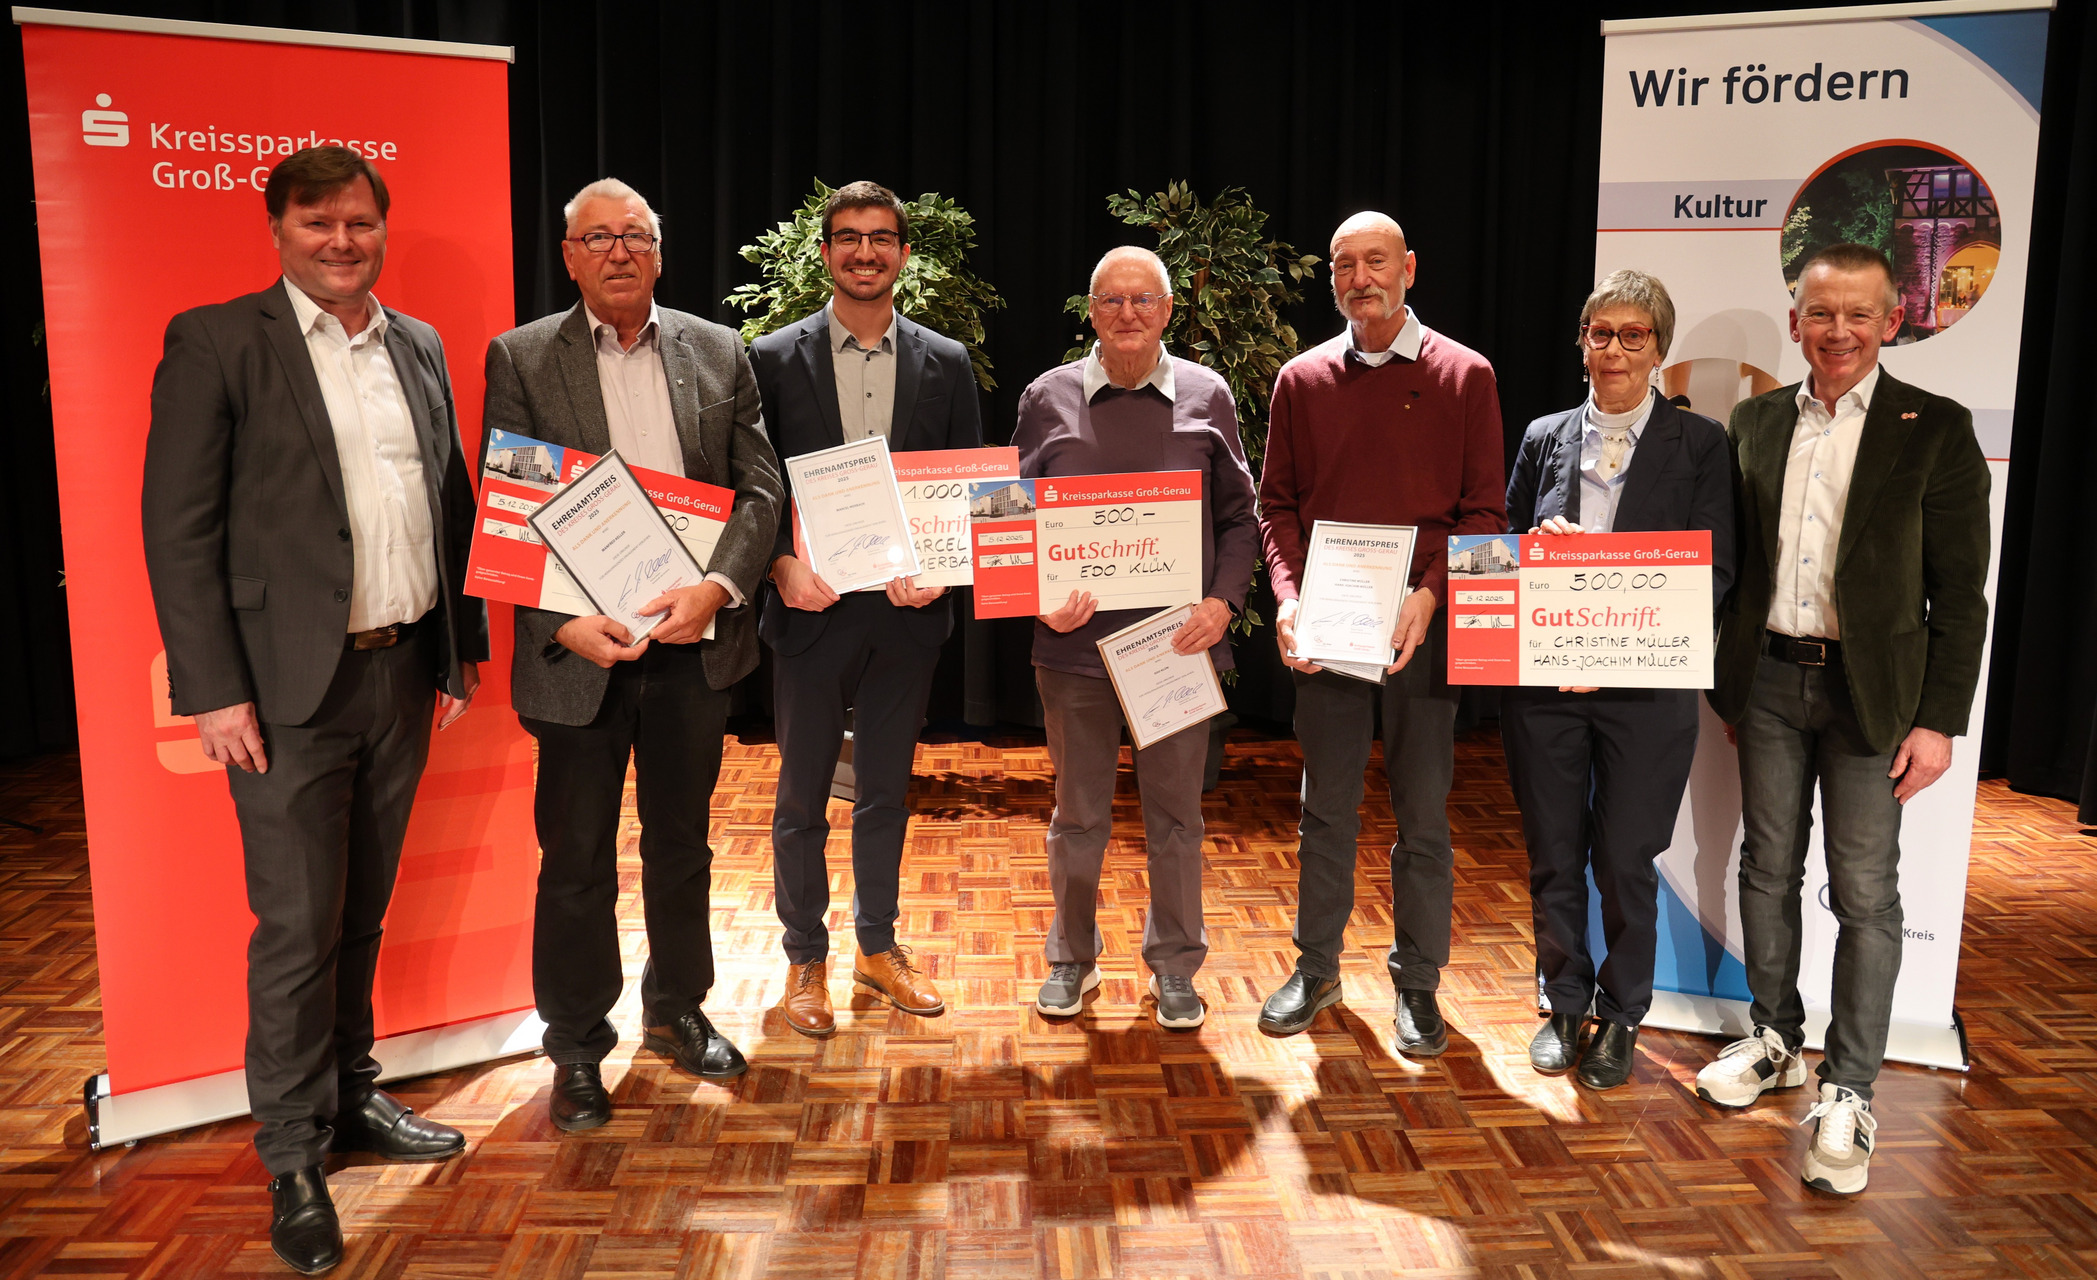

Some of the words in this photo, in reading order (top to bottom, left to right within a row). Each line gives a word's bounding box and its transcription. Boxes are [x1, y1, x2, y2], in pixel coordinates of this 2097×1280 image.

[1628, 66, 1710, 108] Wir
[1722, 62, 1911, 106] fördern
[152, 161, 269, 191] Groß-G
[1673, 193, 1768, 219] Kultur
[803, 454, 877, 479] EHRENAMTSPREIS
[892, 466, 953, 477] eissparkasse
[954, 463, 1009, 474] Groß-Gerau
[551, 474, 617, 531] EHRENAMTSPREIS
[1062, 488, 1134, 503] Kreissparkasse
[1135, 486, 1192, 498] Groß-Gerau
[556, 525, 569, 537] DES
[568, 509, 588, 529] KREISES
[587, 482, 622, 512] GROSS-GERAU
[666, 492, 722, 514] Groß-Gerau
[588, 509, 600, 520] 2025
[1045, 520, 1064, 529] Euro
[914, 537, 967, 553] ARCEL
[1325, 537, 1400, 549] EHRENAMTSPREIS
[1549, 549, 1631, 563] Kreissparkasse
[1633, 548, 1699, 560] Groß-Gerau
[1046, 572, 1058, 582] für
[1080, 564, 1117, 578] EDO
[1529, 580, 1550, 590] Euro
[1569, 571, 1668, 594] 500,00
[1115, 620, 1184, 656] EHRENAMTSPREIS
[1528, 639, 1542, 649] für
[1635, 633, 1691, 649] MÜLLER
[1533, 654, 1632, 671] HANS-JOACHIM
[1636, 652, 1689, 668] MÜLLER
[1902, 928, 1936, 941] Kreis
